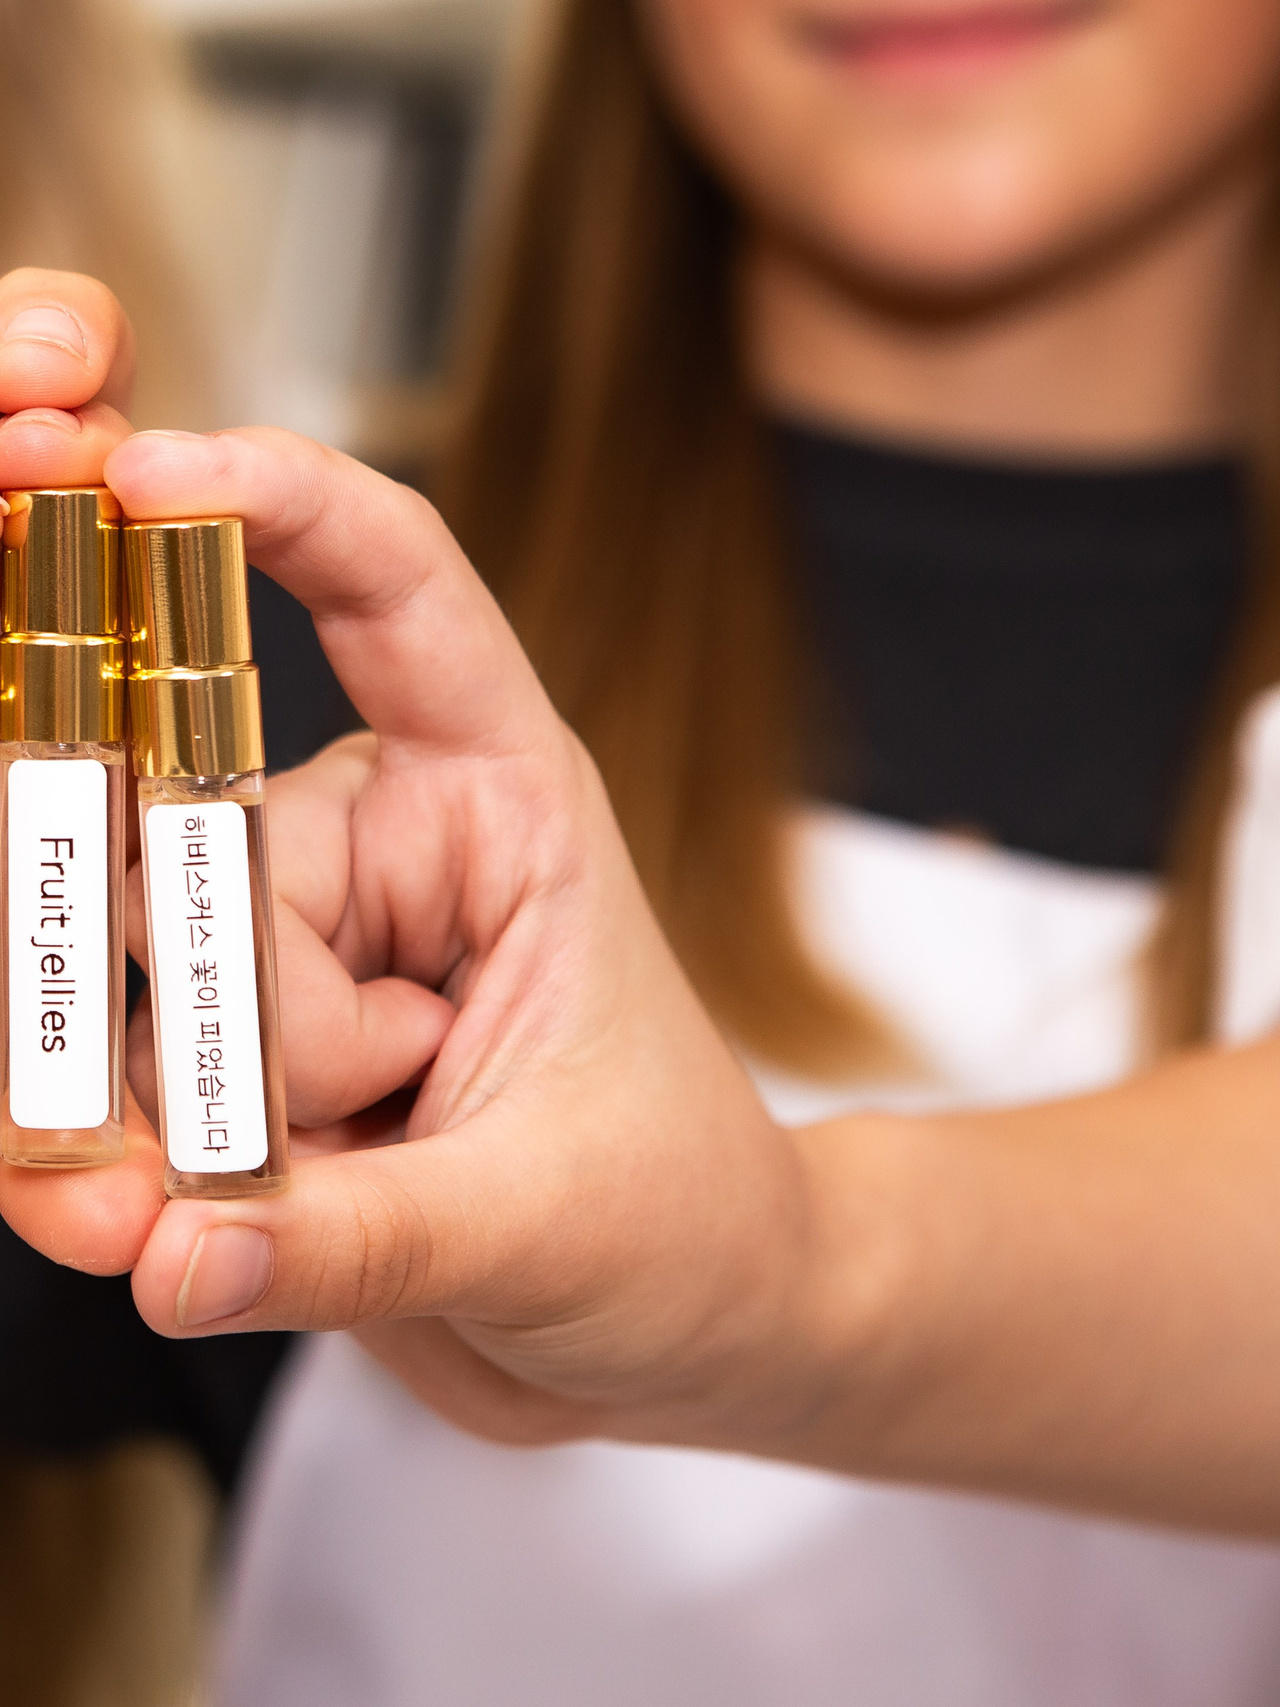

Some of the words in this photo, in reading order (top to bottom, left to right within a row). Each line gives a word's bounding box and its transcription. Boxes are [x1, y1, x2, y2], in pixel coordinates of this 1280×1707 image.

[39, 836, 75, 930] Fruit
[180, 815, 215, 950] 히비스커스
[30, 934, 77, 1054] jellies
[188, 958, 221, 1010] 꽃이
[195, 1020, 231, 1155] 피었습니다
